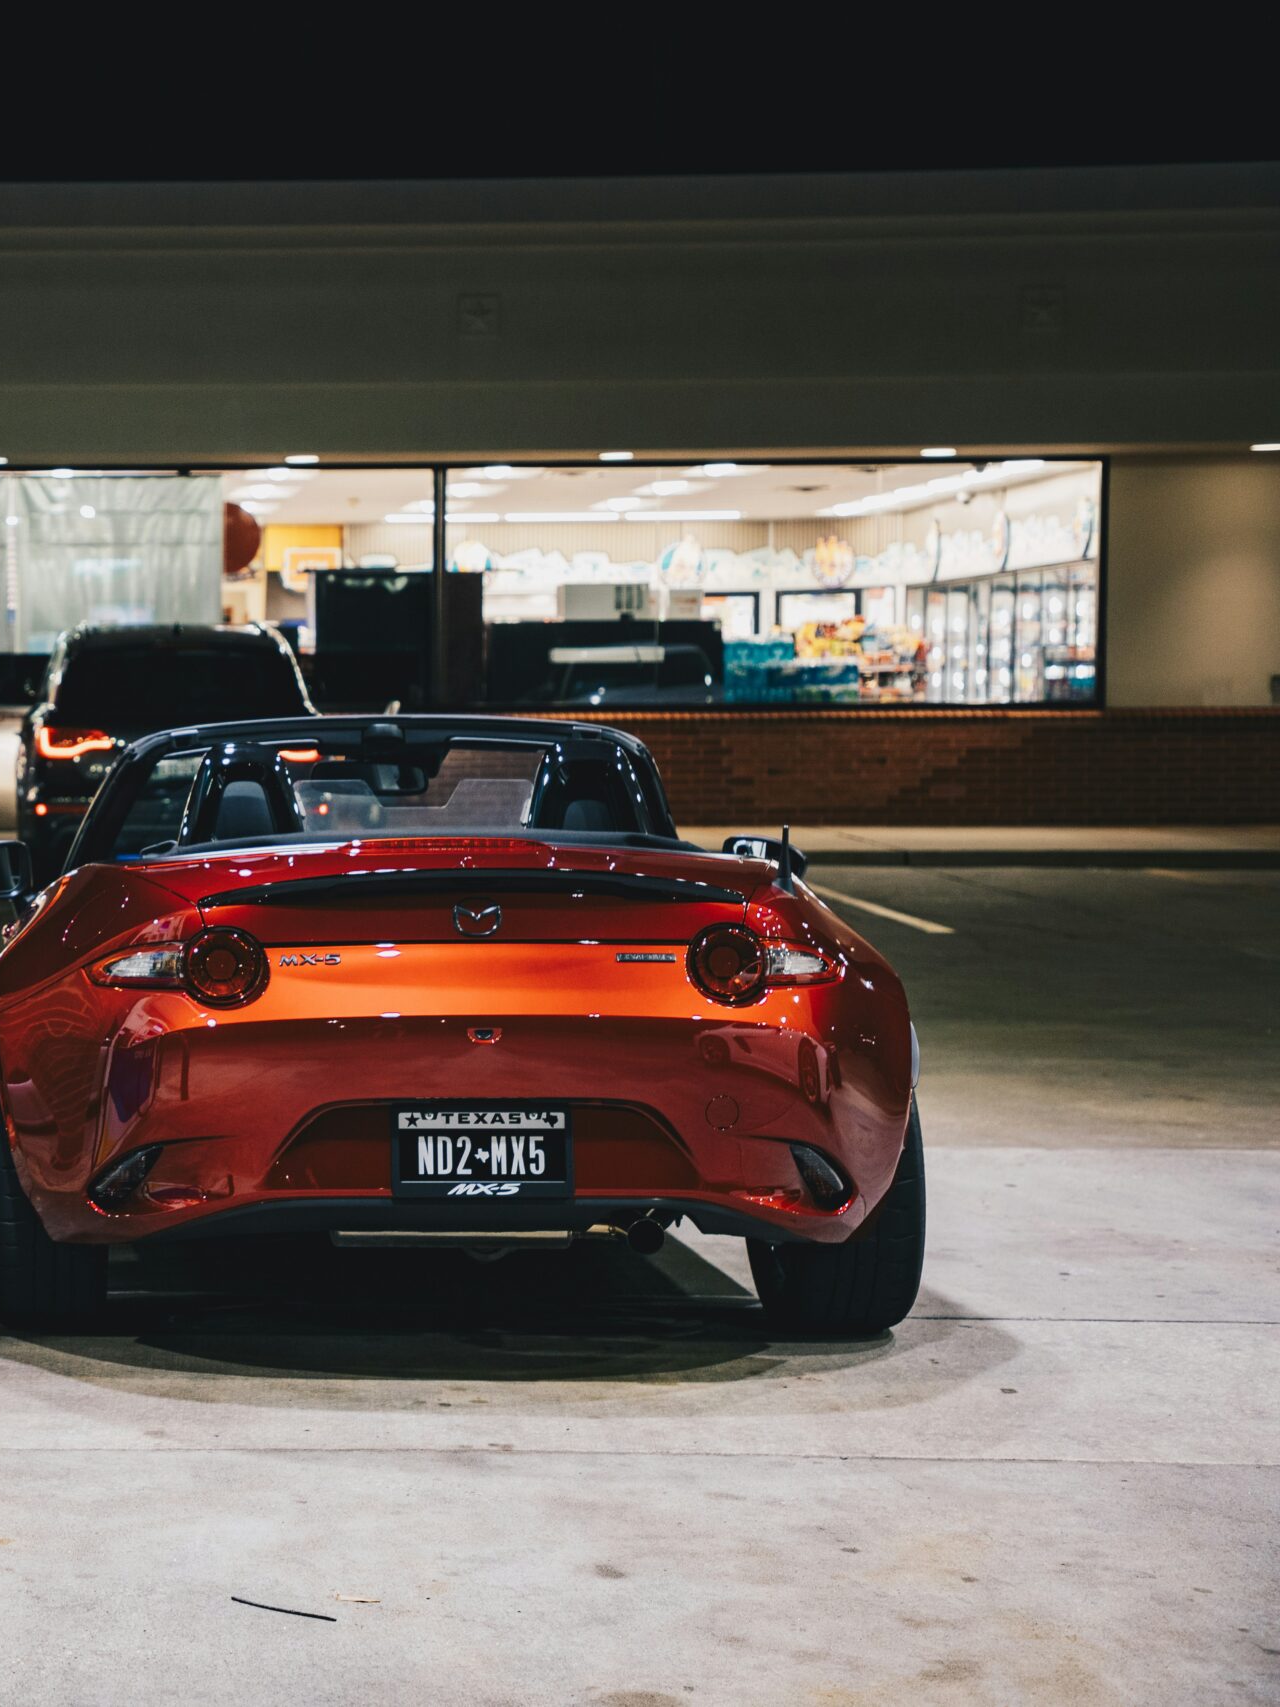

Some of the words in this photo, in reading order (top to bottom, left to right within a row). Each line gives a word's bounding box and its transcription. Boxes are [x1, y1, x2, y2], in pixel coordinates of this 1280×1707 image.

[279, 953, 341, 967] MX-5
[441, 1112, 522, 1125] TEXAS
[418, 1135, 473, 1175] ND2
[490, 1135, 546, 1175] MX5
[447, 1183, 522, 1196] MX-5
